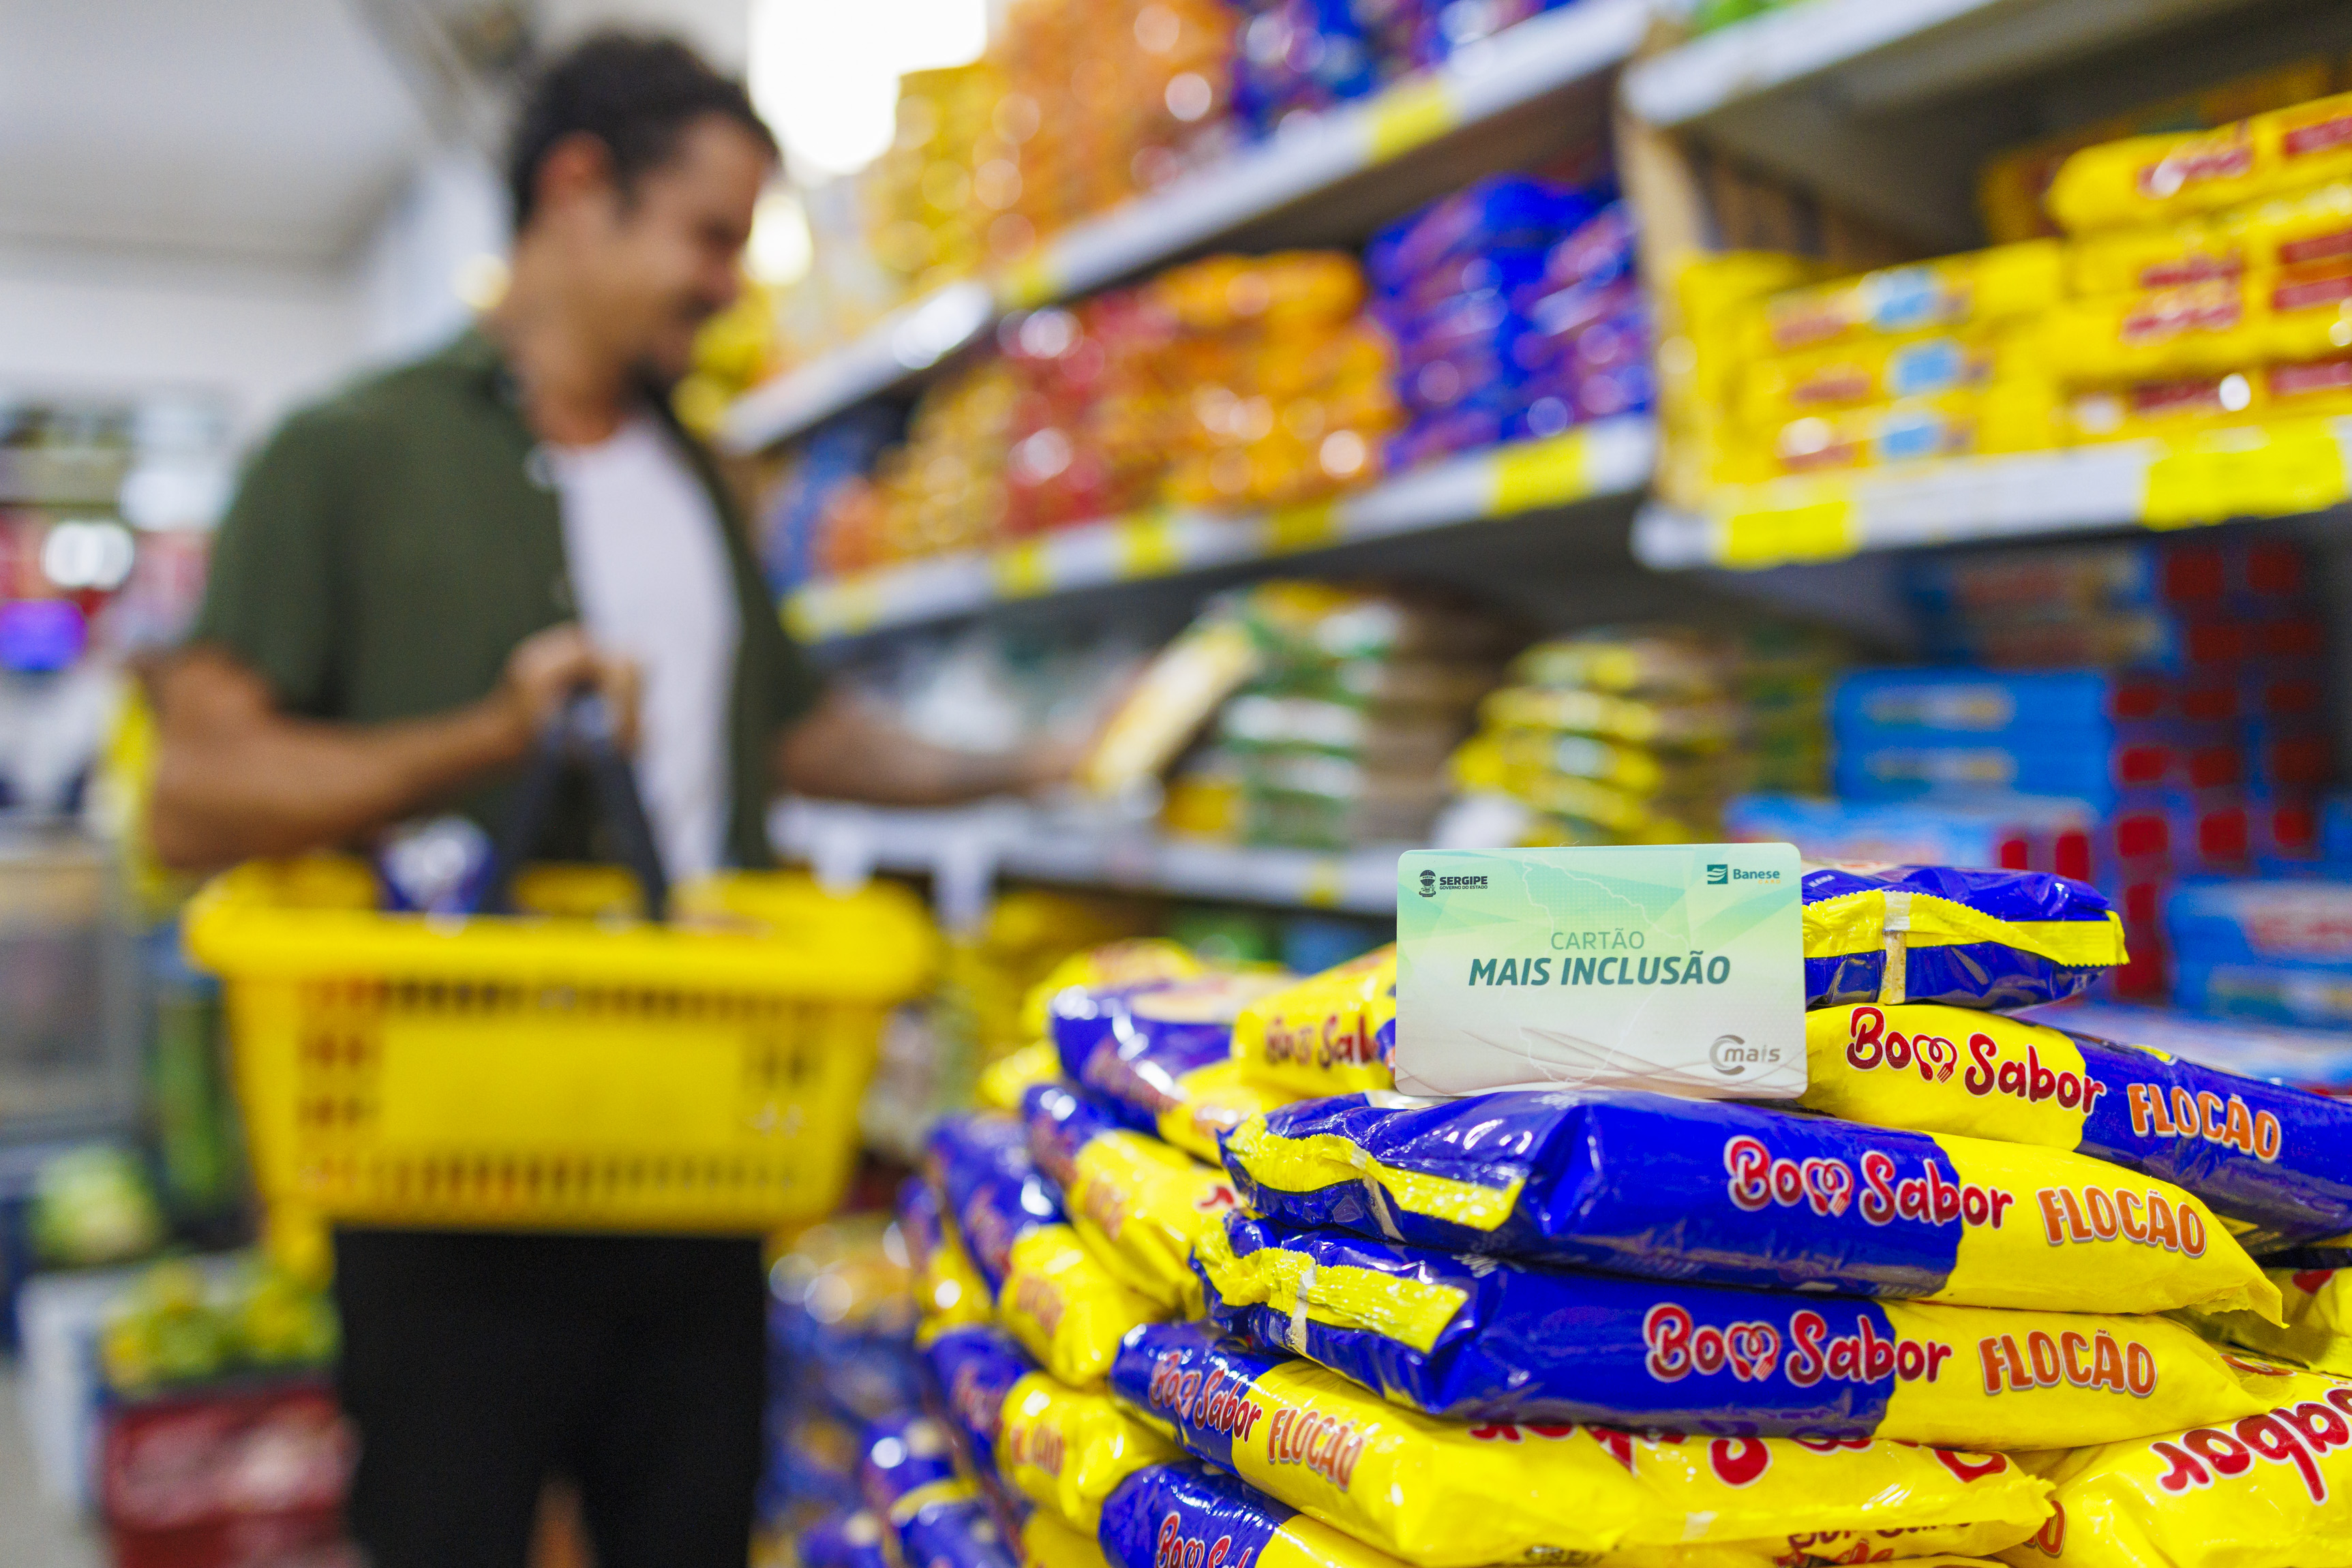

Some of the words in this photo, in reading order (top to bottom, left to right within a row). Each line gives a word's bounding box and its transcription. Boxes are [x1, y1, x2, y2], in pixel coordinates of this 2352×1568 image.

[1439, 876, 1488, 886] SERGIPE
[1733, 869, 1781, 879] Banese
[1550, 928, 1645, 951] CARTÃO
[1468, 957, 1551, 986] MAIS
[1561, 950, 1730, 985] INCLUSÃO
[1963, 1033, 2107, 1116] Sabor
[2126, 1082, 2282, 1163] FLOCÃO
[1859, 1150, 2015, 1229] Sabor
[2037, 1186, 2208, 1258] FLOCÃO
[1784, 1310, 1953, 1388] Sabor
[1978, 1329, 2158, 1398] FLOCÃO
[1193, 1366, 1263, 1443] Sabor
